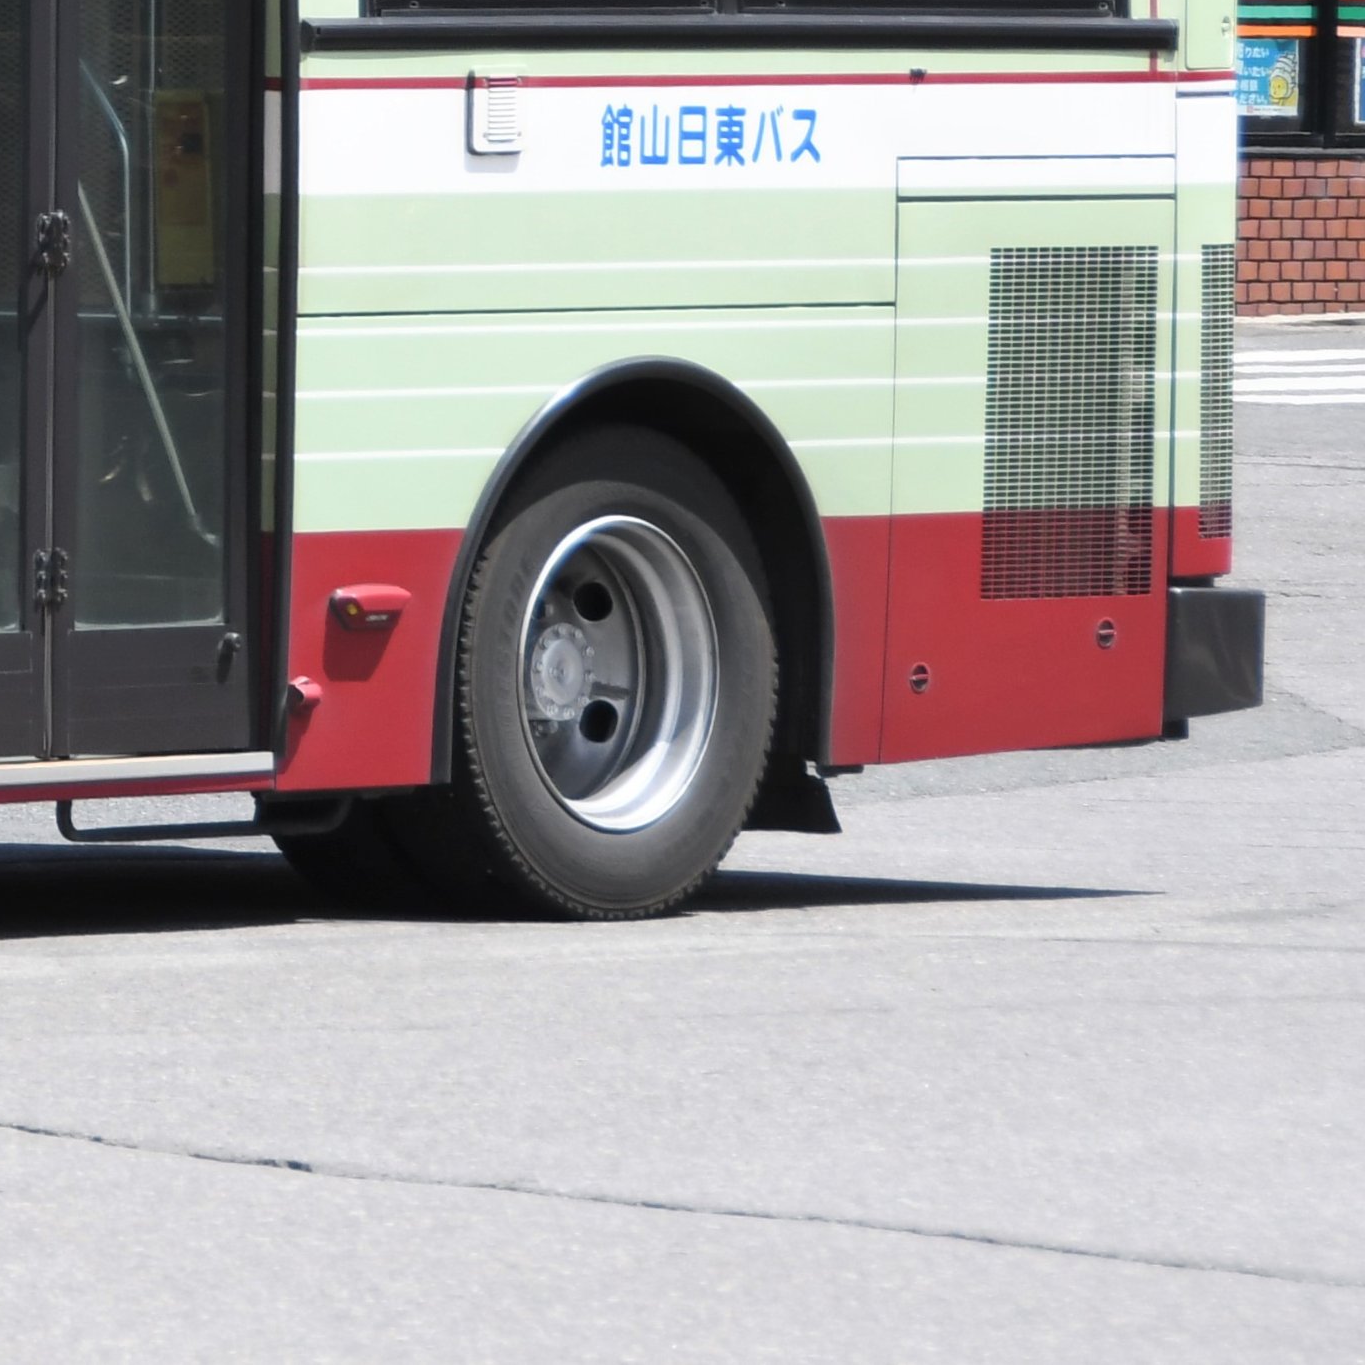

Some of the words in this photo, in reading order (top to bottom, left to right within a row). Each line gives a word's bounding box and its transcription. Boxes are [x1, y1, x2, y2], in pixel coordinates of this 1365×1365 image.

[600, 103, 822, 167] 館山日東バス
